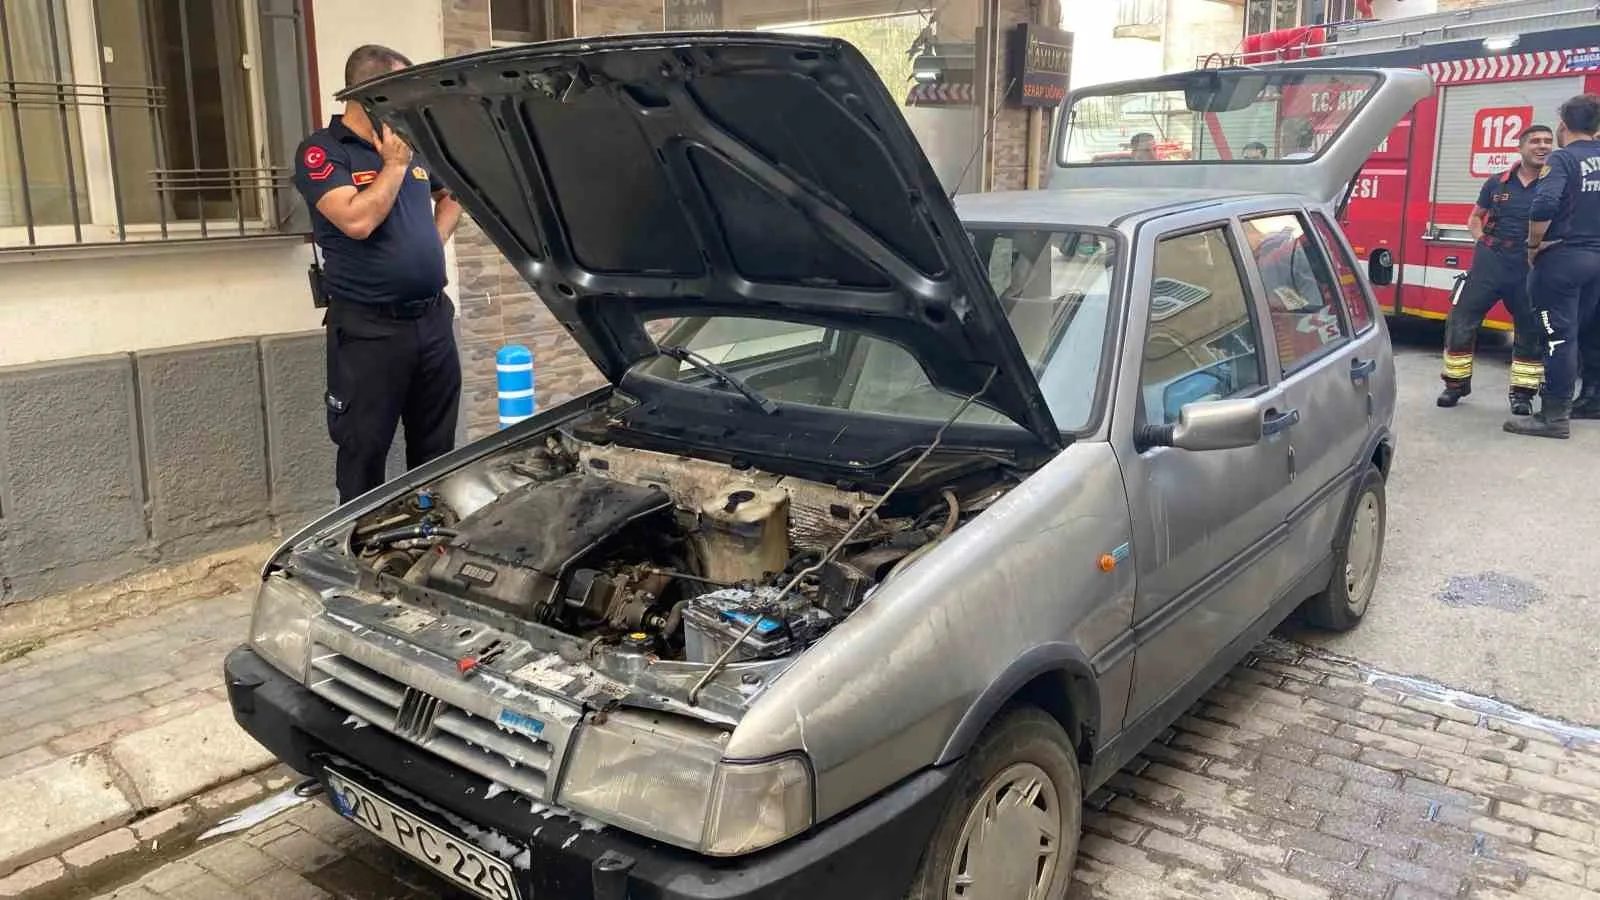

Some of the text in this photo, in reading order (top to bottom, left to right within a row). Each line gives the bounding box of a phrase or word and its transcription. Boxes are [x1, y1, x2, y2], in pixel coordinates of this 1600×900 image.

[1482, 114, 1522, 148] 112
[343, 785, 511, 900] 20 PC 229
